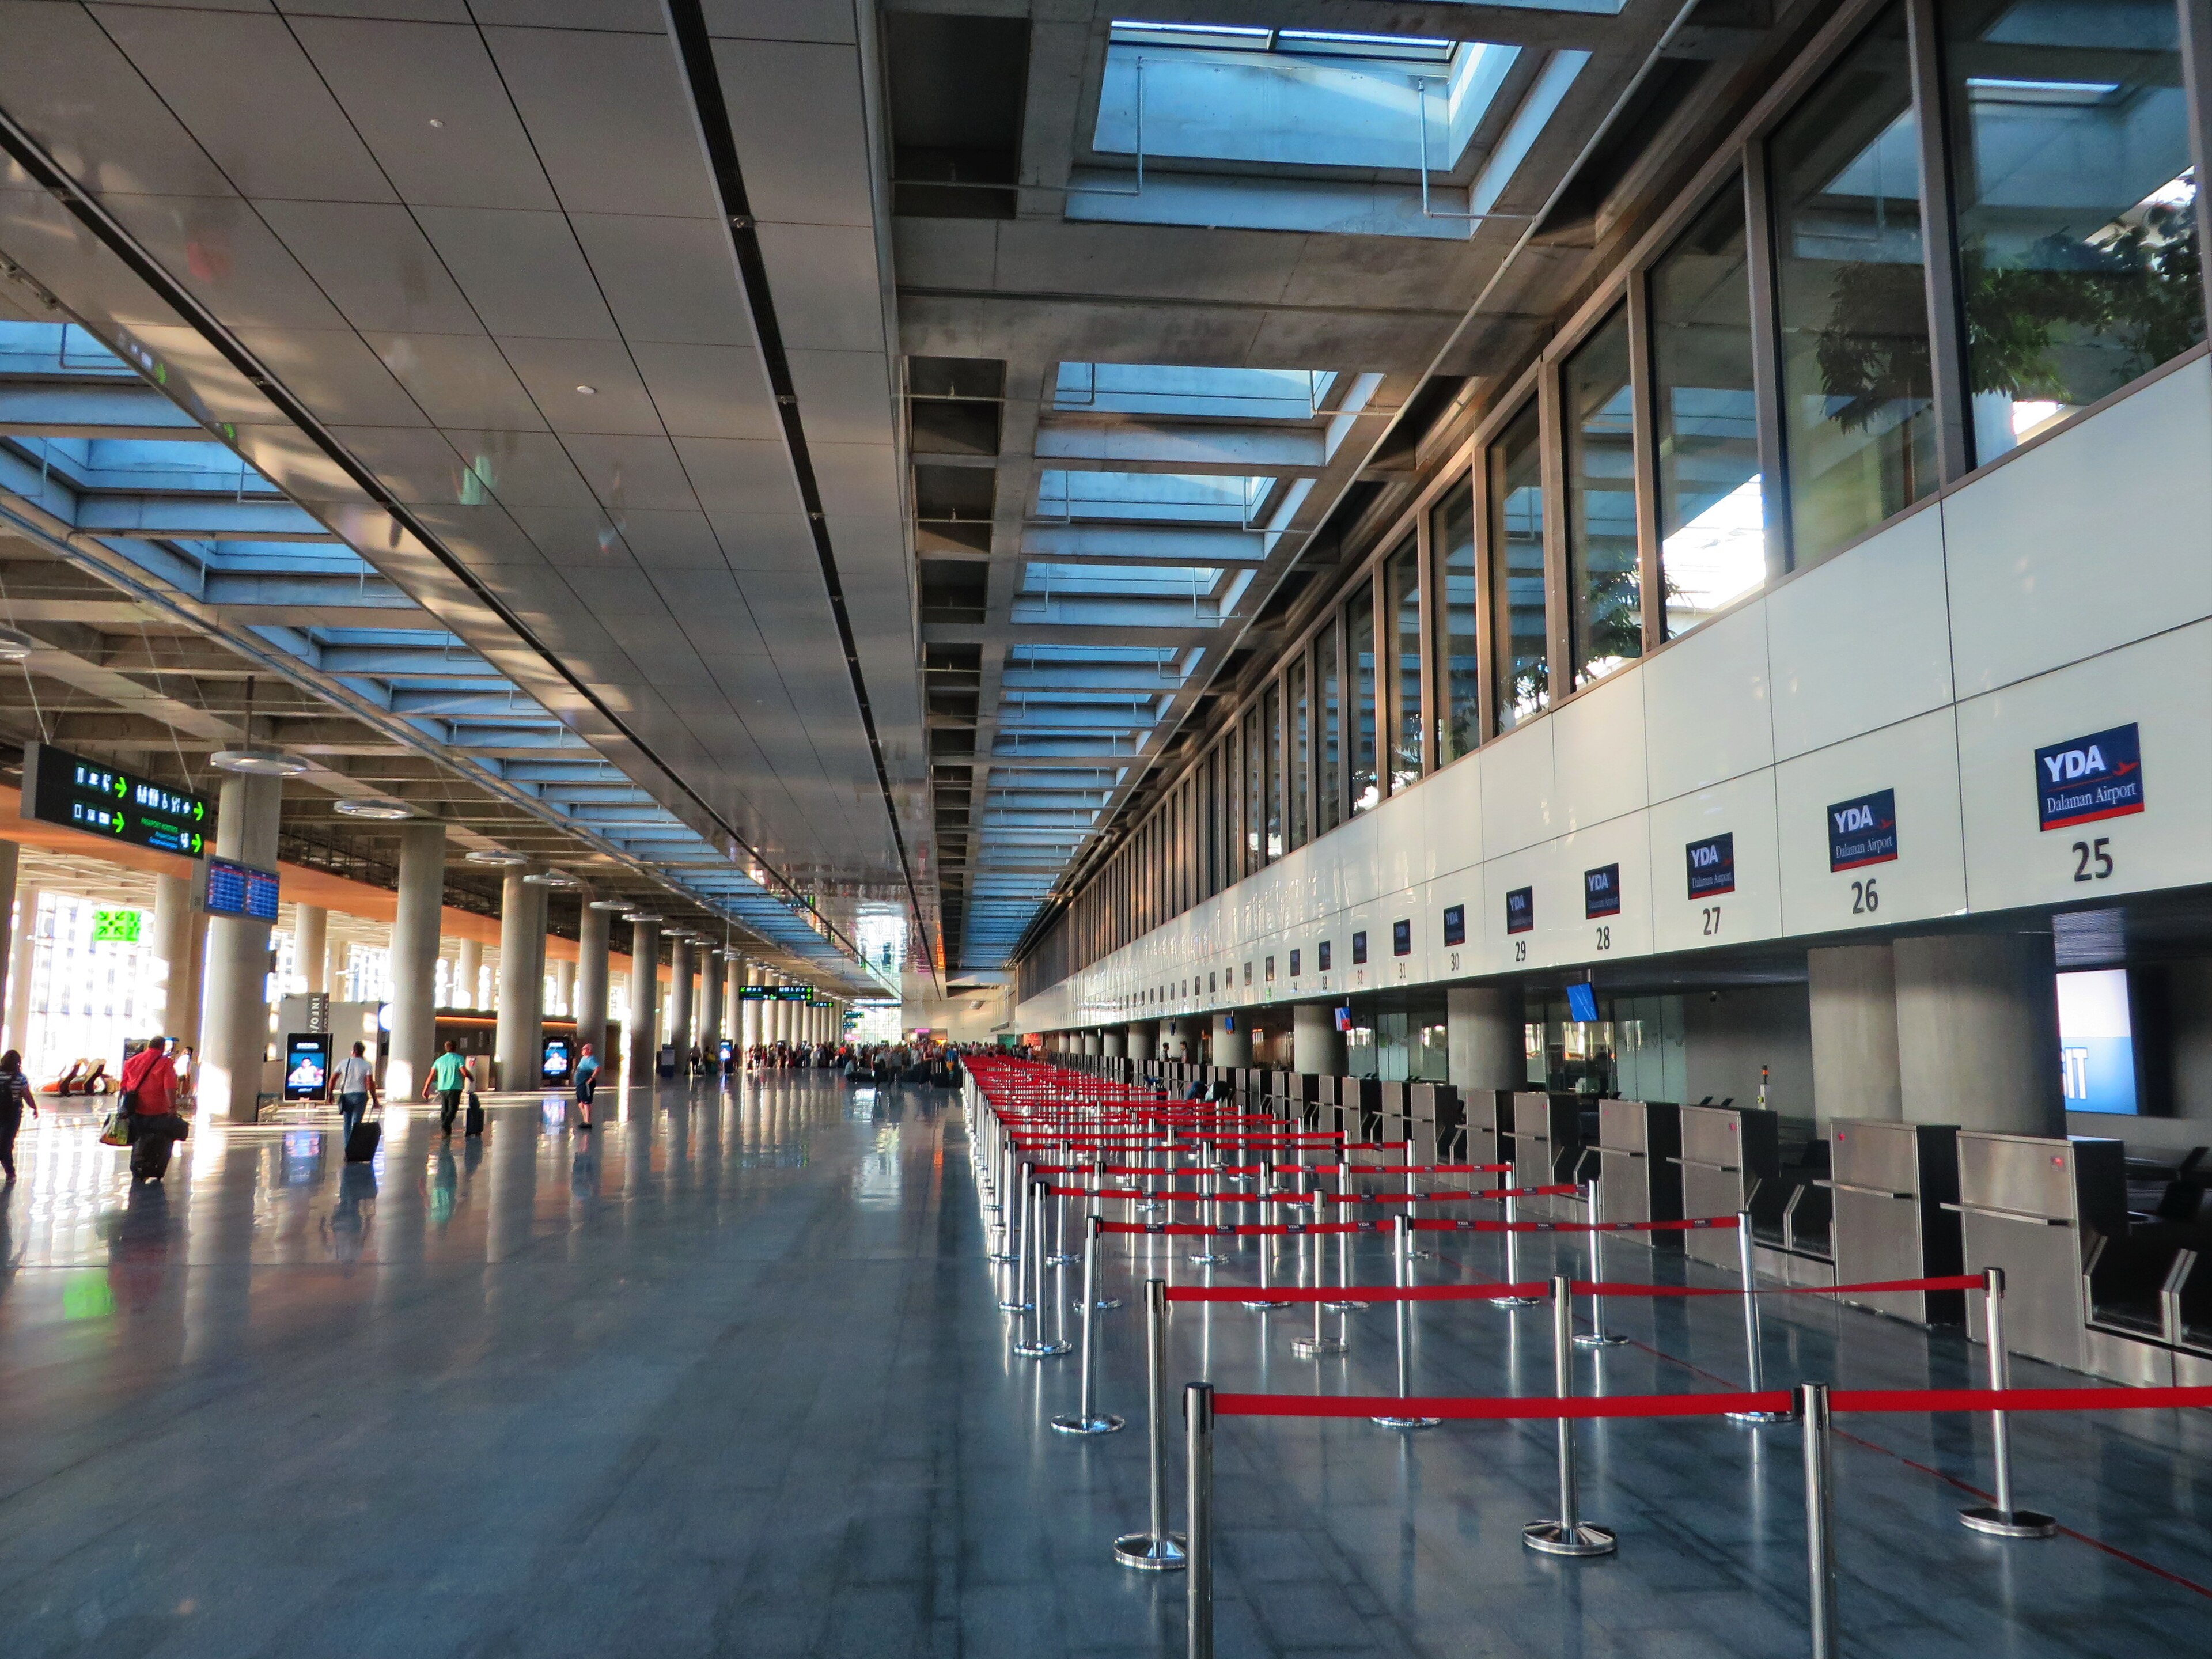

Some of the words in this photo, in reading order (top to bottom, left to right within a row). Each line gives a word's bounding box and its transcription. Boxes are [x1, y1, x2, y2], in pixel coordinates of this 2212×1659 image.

[2044, 745, 2107, 782] YDA
[2047, 792, 2093, 813] Dalaman
[2096, 783, 2137, 805] Airport
[1834, 805, 1873, 834] YDA
[1691, 844, 1719, 868] YDA
[1836, 842, 1865, 858] Dalaman
[1867, 836, 1892, 853] Airport
[2072, 838, 2113, 882] 25
[1588, 872, 1609, 892] YDA
[1510, 895, 1525, 911] YDA
[1851, 878, 1878, 914] 26
[1702, 907, 1721, 935] 27
[1596, 926, 1610, 950] 28
[1451, 952, 1459, 971] 30
[1516, 941, 1526, 962] 29
[1399, 963, 1406, 979] 31
